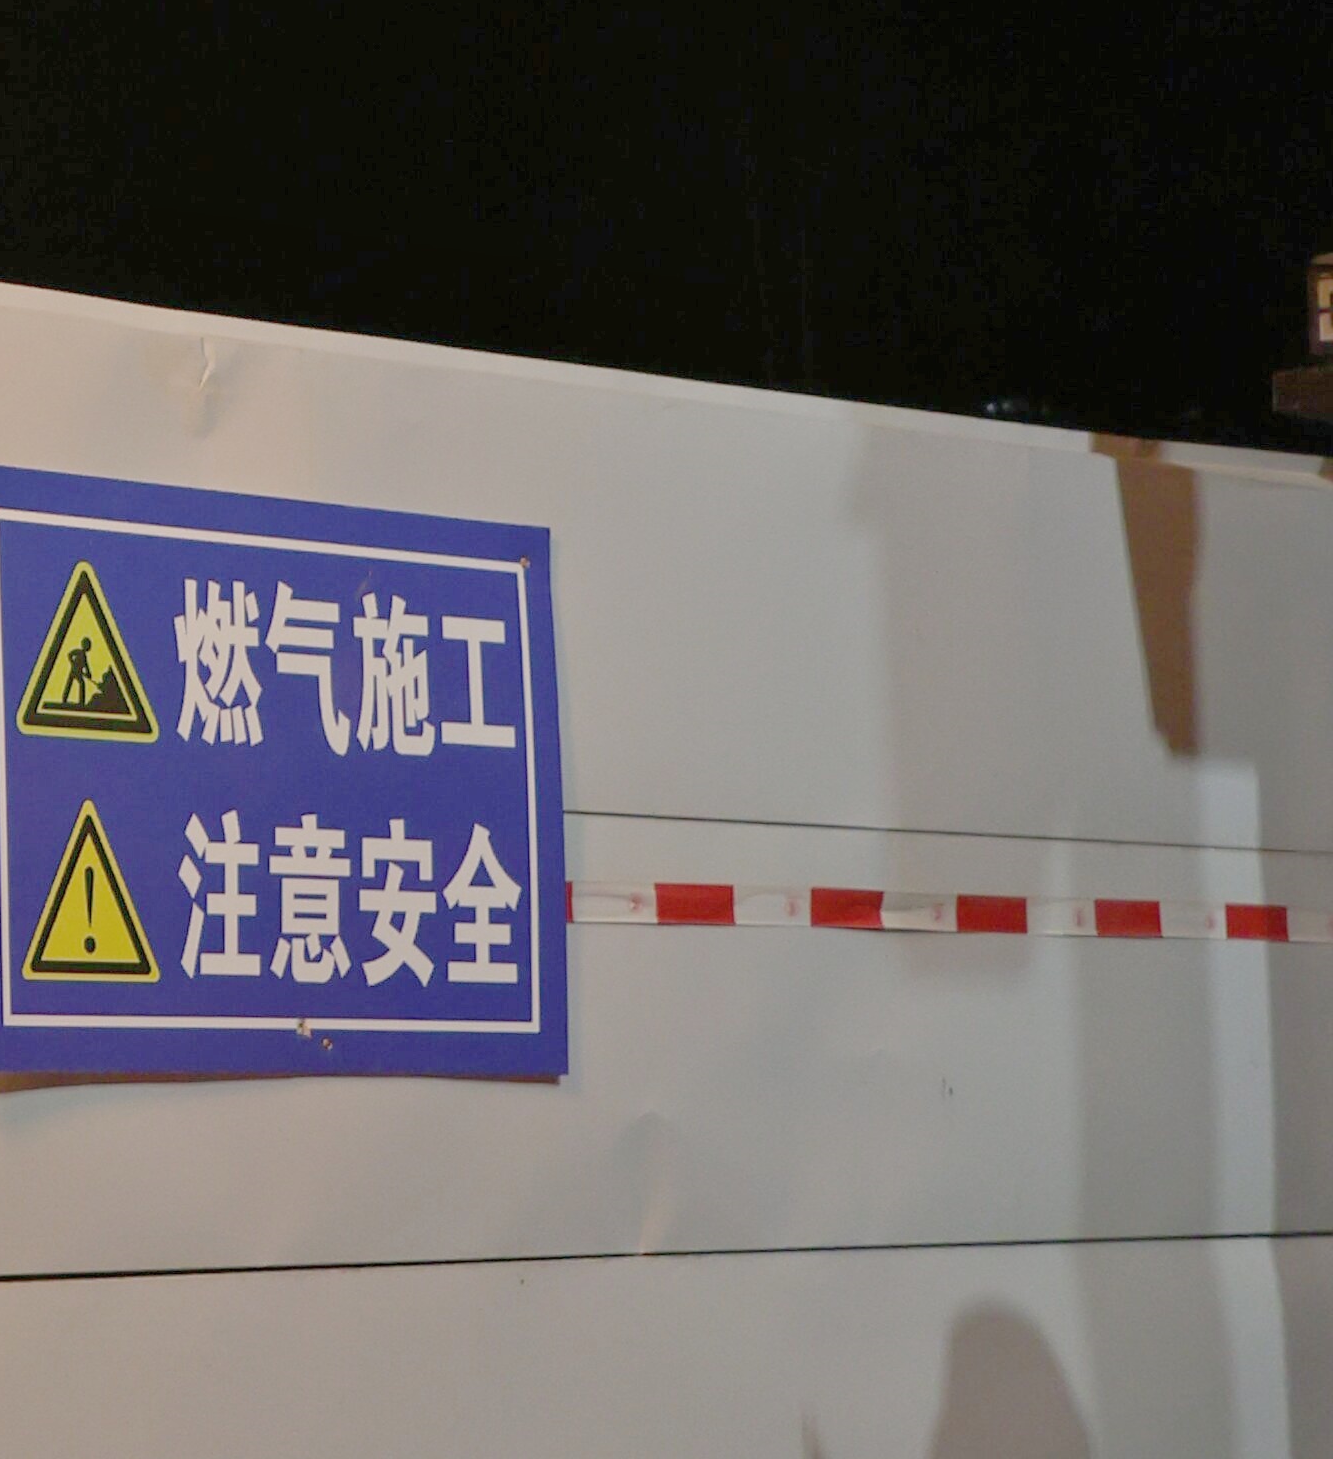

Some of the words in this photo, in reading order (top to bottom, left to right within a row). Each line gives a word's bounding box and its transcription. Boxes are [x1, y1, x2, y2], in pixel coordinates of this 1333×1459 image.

[174, 578, 516, 756] 燃气施工
[178, 810, 522, 987] 注意安全
